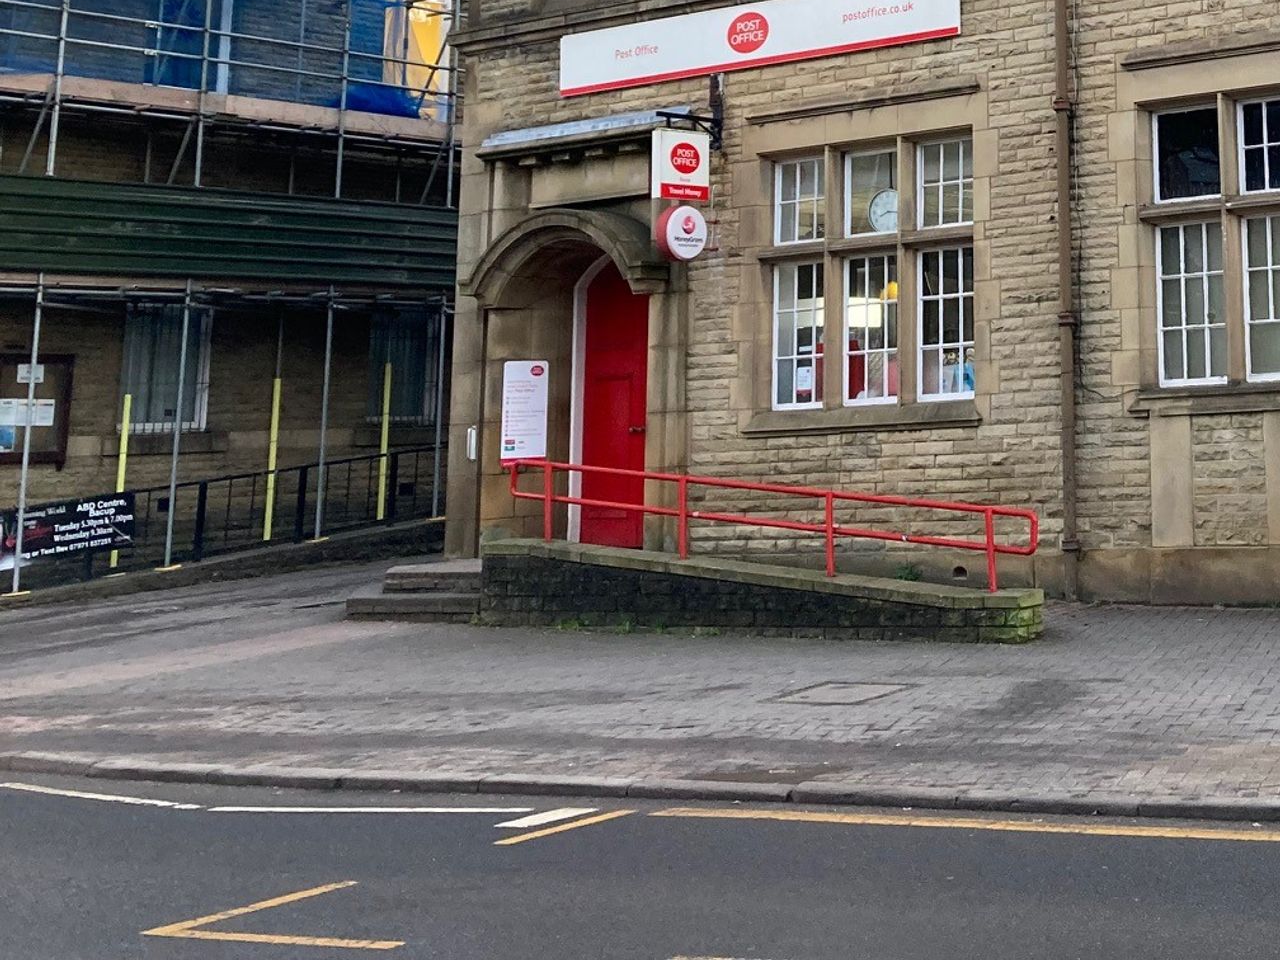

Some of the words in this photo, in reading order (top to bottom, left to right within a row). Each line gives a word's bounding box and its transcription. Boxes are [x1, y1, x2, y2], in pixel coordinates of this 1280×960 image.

[842, 1, 914, 24] postoffice.co.uk
[736, 19, 761, 32] POST
[730, 30, 764, 45] OFFICE
[615, 48, 632, 60] Post
[634, 44, 659, 57] Office
[677, 148, 695, 158] POST
[673, 157, 697, 167] OFFICE
[685, 188, 702, 198] Money
[97, 499, 127, 509] Centre,
[88, 508, 116, 518] Bacup
[54, 522, 80, 532] Tuesday
[53, 530, 90, 542] Wednesday
